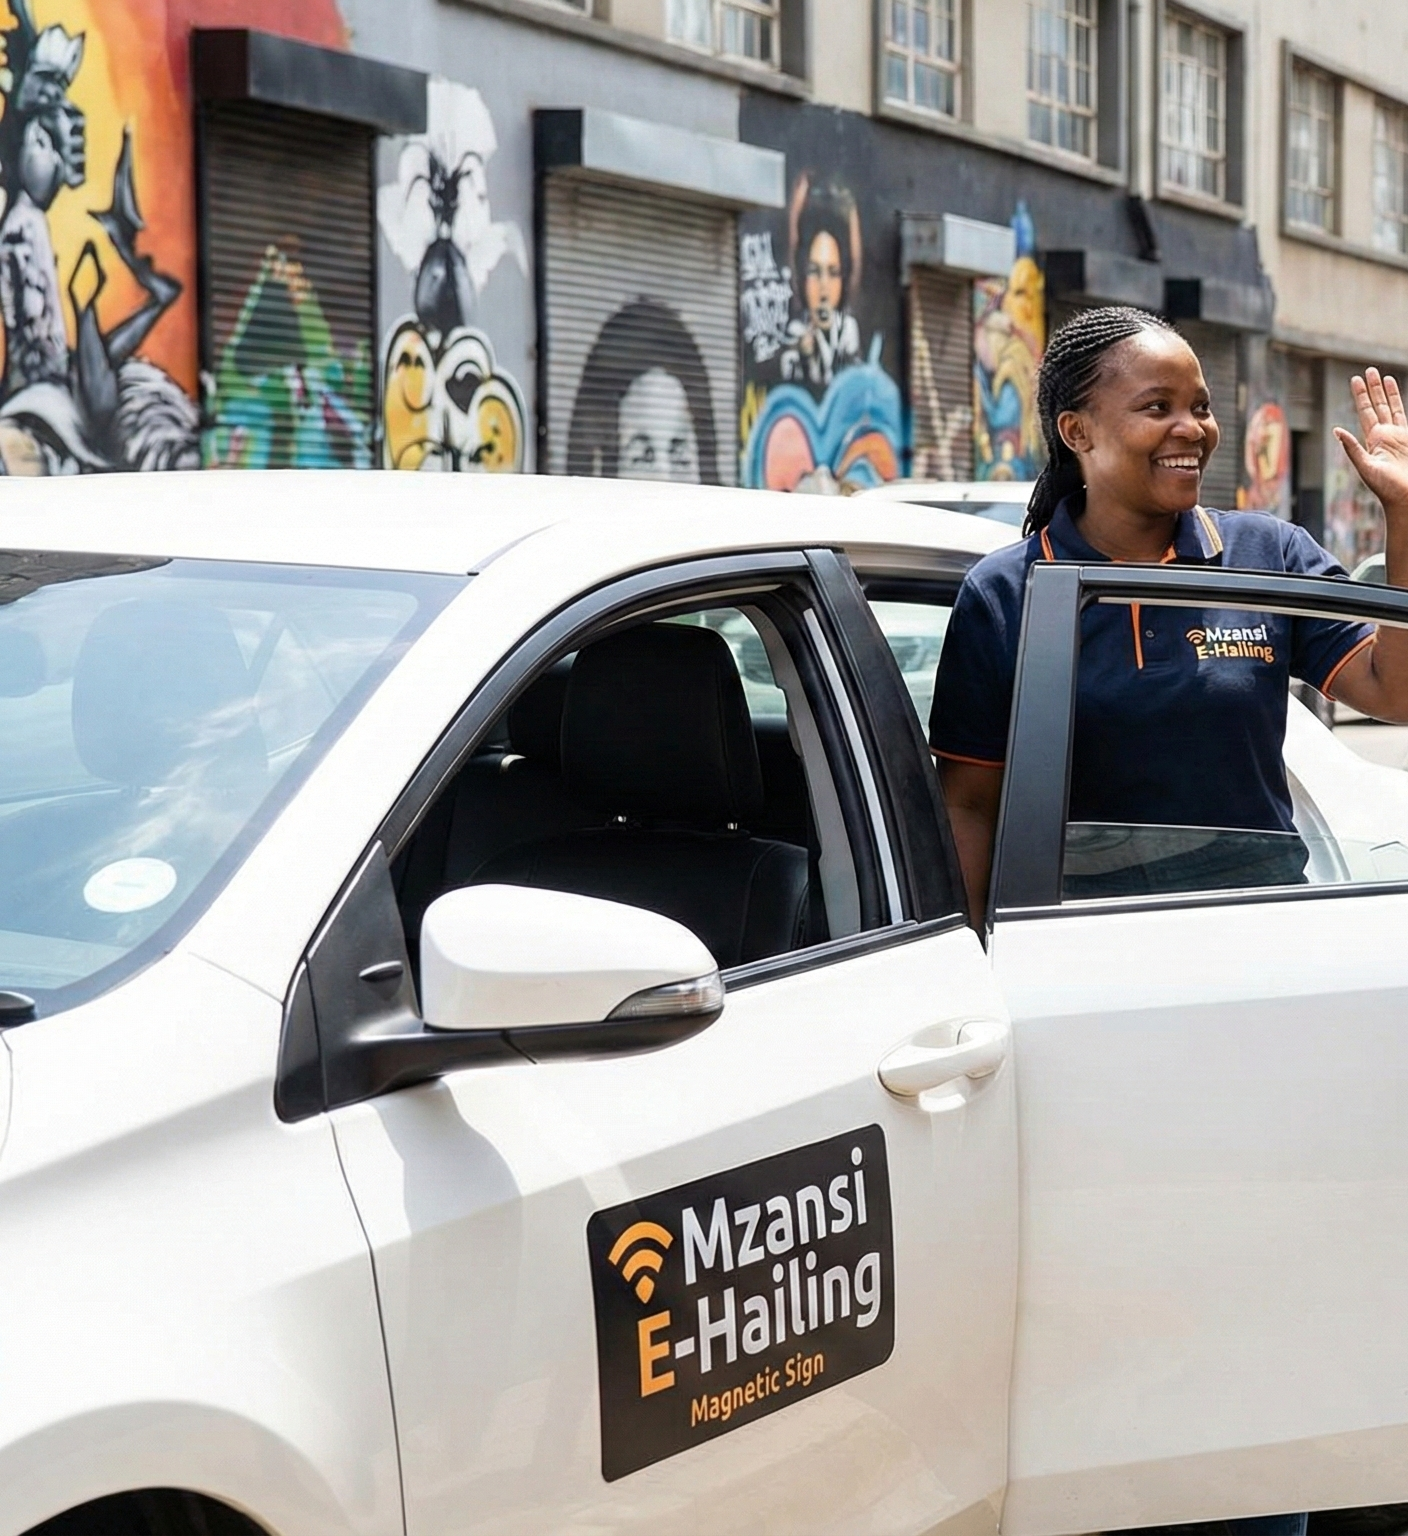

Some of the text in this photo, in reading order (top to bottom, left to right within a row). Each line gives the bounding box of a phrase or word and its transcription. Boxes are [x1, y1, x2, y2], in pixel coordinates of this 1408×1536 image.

[1206, 624, 1267, 642] Mzansi
[681, 1146, 868, 1286] Mzansi
[637, 1250, 882, 1398] E-Hailing
[690, 1352, 825, 1428] Magnetic Sign
